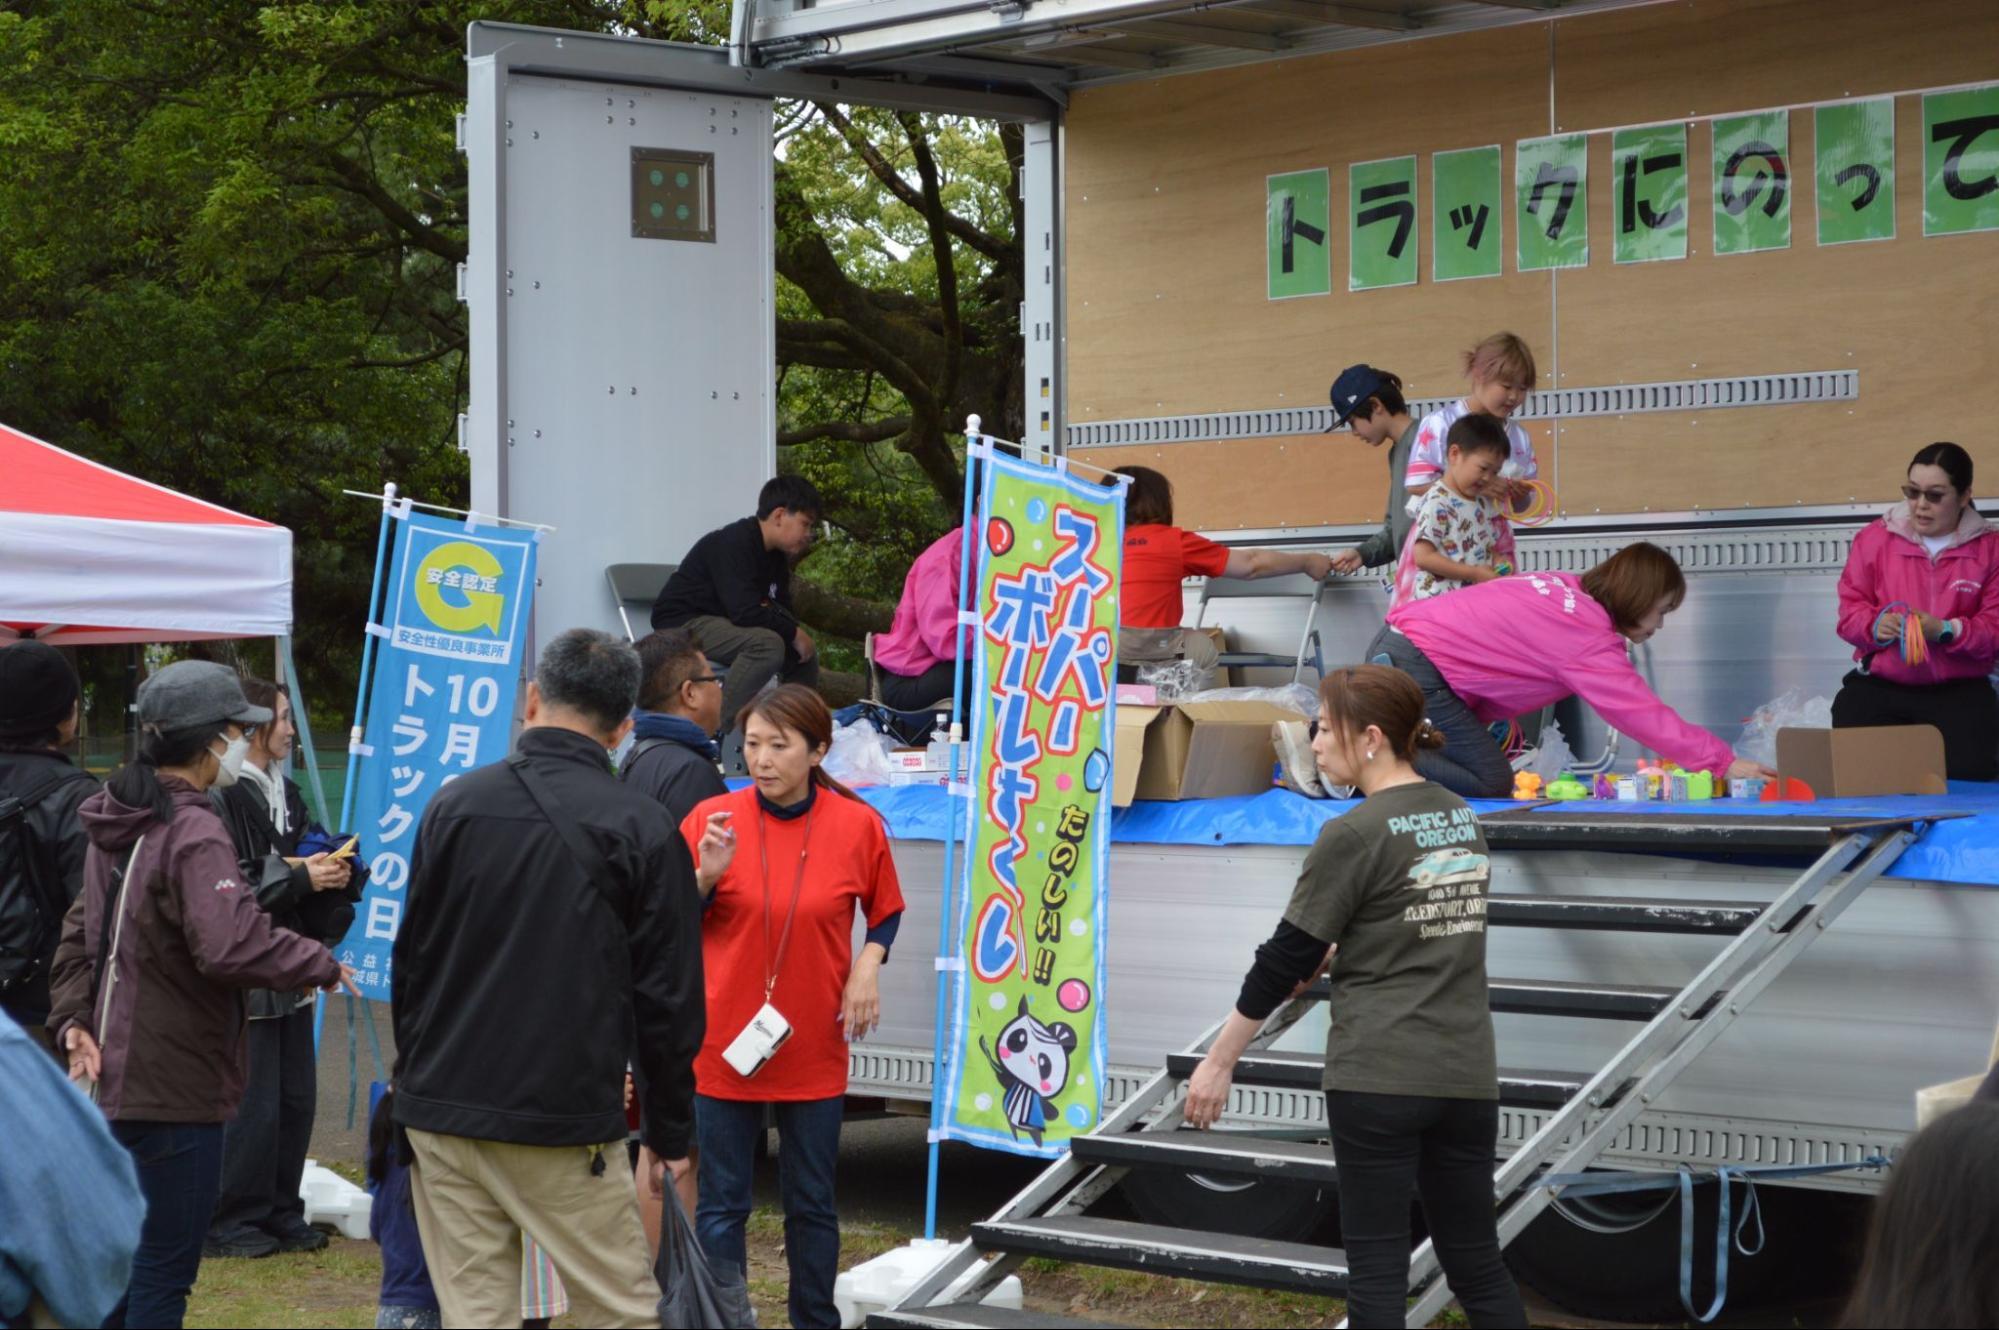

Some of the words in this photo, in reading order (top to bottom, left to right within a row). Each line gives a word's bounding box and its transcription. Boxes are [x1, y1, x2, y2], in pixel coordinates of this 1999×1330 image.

[1281, 115, 1999, 273] トラックにのって
[426, 567, 497, 592] 安全認定
[399, 630, 505, 658] 安全性優良事業所
[1034, 503, 1113, 752] スーパー
[438, 674, 499, 787] 10月
[364, 664, 434, 942] トラックの日
[1388, 811, 1448, 835] PACIFIC
[1451, 807, 1480, 825] AUT
[1416, 824, 1477, 848] OREGON
